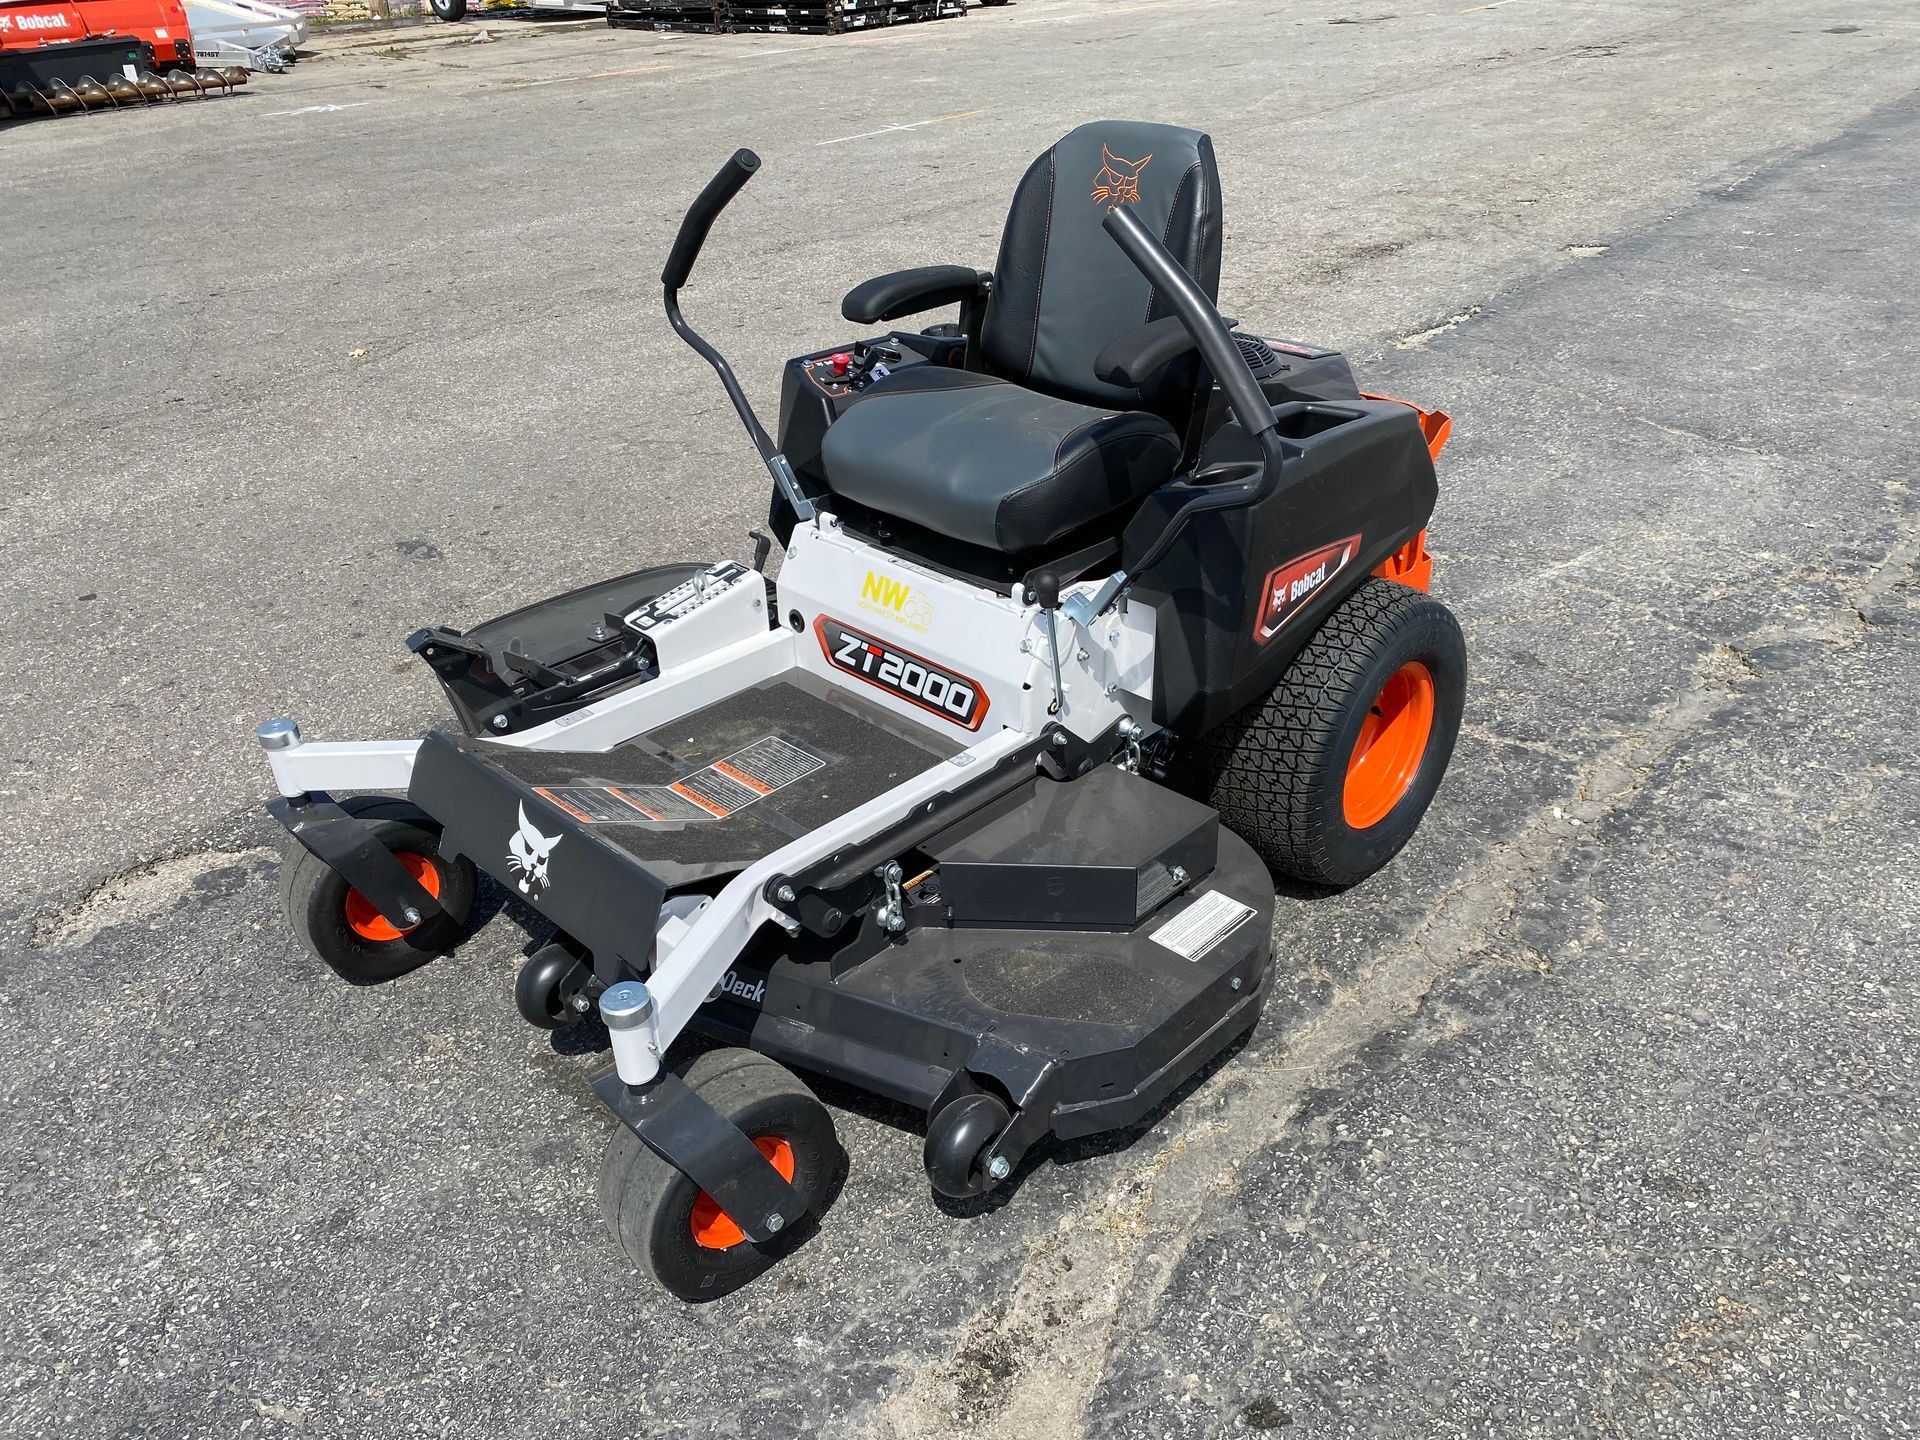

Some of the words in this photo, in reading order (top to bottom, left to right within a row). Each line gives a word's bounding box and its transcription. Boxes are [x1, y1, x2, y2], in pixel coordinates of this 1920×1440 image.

[15, 13, 67, 30] Bobcat
[861, 571, 911, 612] NW
[1290, 561, 1326, 602] Bobcat
[834, 632, 974, 718] ZT2000
[722, 970, 766, 1003] Deck
